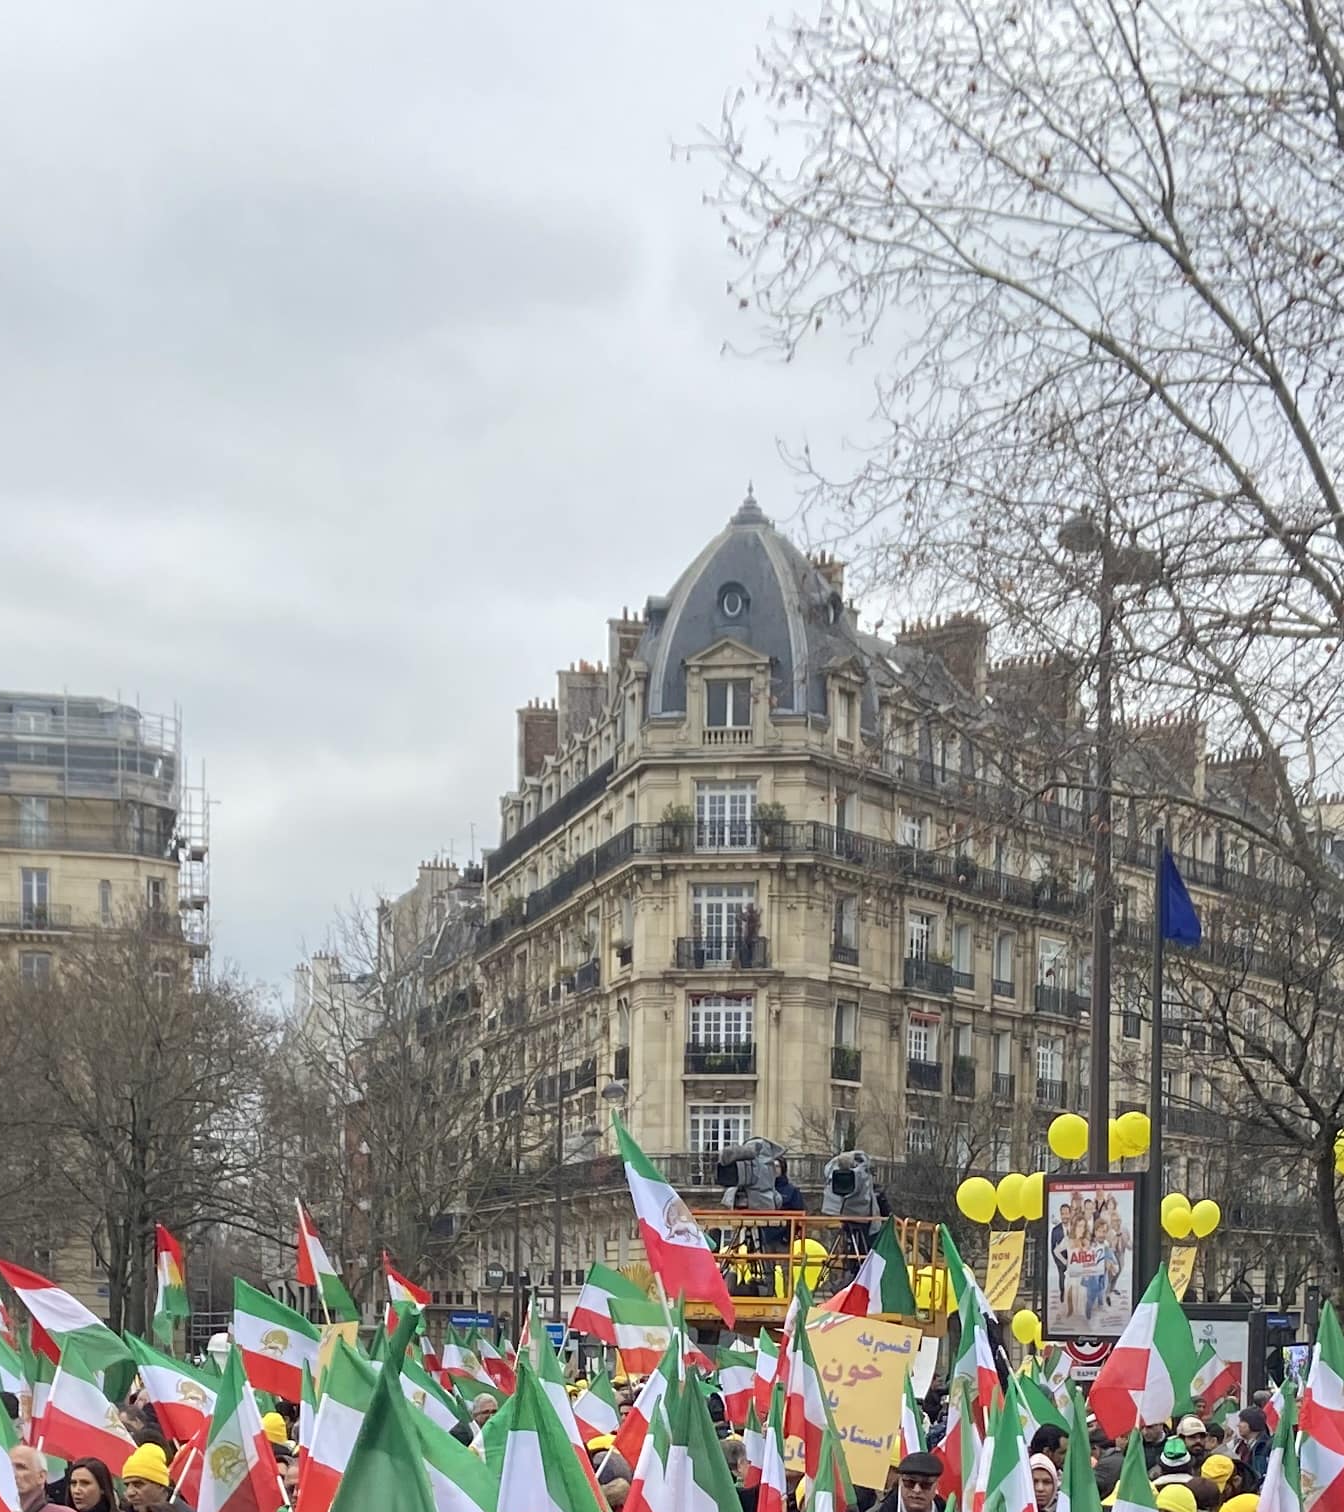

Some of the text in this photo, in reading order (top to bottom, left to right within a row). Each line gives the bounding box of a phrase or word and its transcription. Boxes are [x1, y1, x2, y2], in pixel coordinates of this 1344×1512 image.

[856, 1331, 912, 1355] قسم به
[822, 1357, 882, 1387] خون
